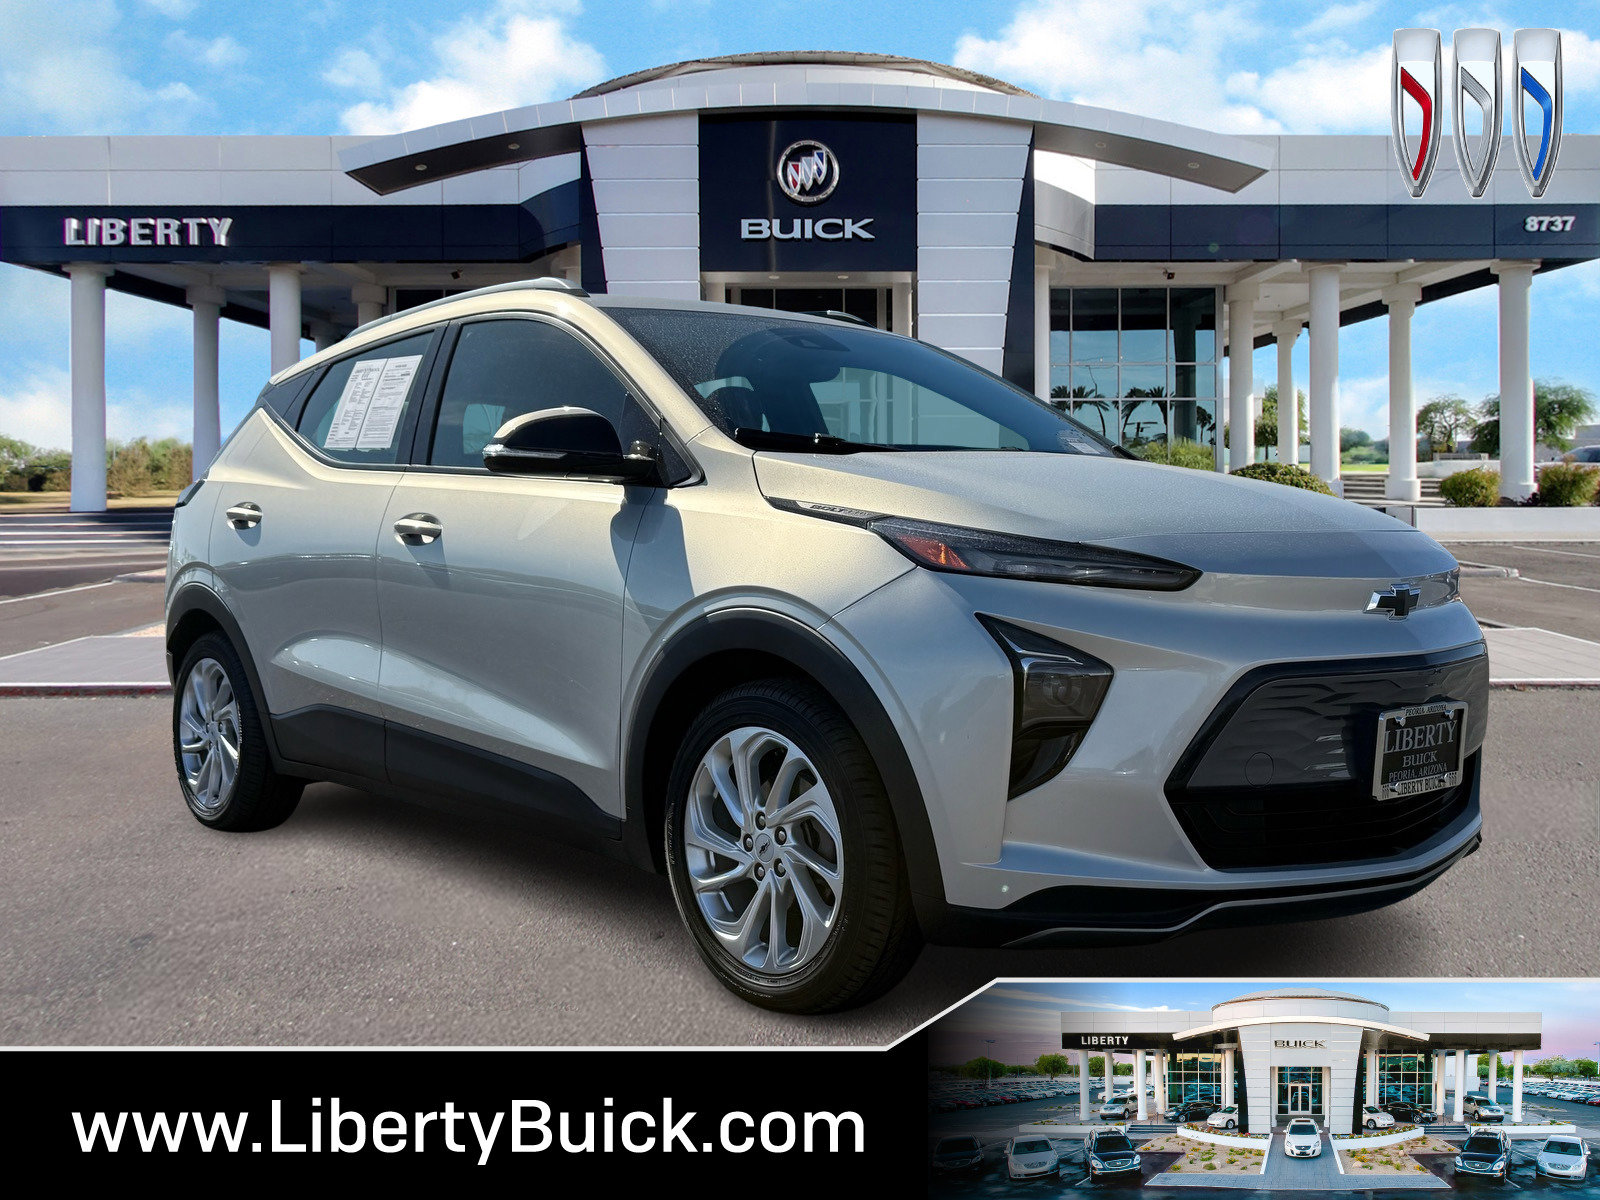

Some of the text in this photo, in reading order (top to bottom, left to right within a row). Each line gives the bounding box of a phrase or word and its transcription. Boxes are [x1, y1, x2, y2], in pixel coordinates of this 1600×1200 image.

[64, 217, 233, 246] LIBERTY
[740, 218, 876, 239] BUICK
[1524, 215, 1576, 232] 8737
[1384, 720, 1457, 753] LIBERTY
[1402, 751, 1438, 768] BUICK
[1419, 762, 1447, 777] ARIZONA
[1081, 1035, 1129, 1046] LIBERTY
[1274, 1039, 1327, 1049] BUICK
